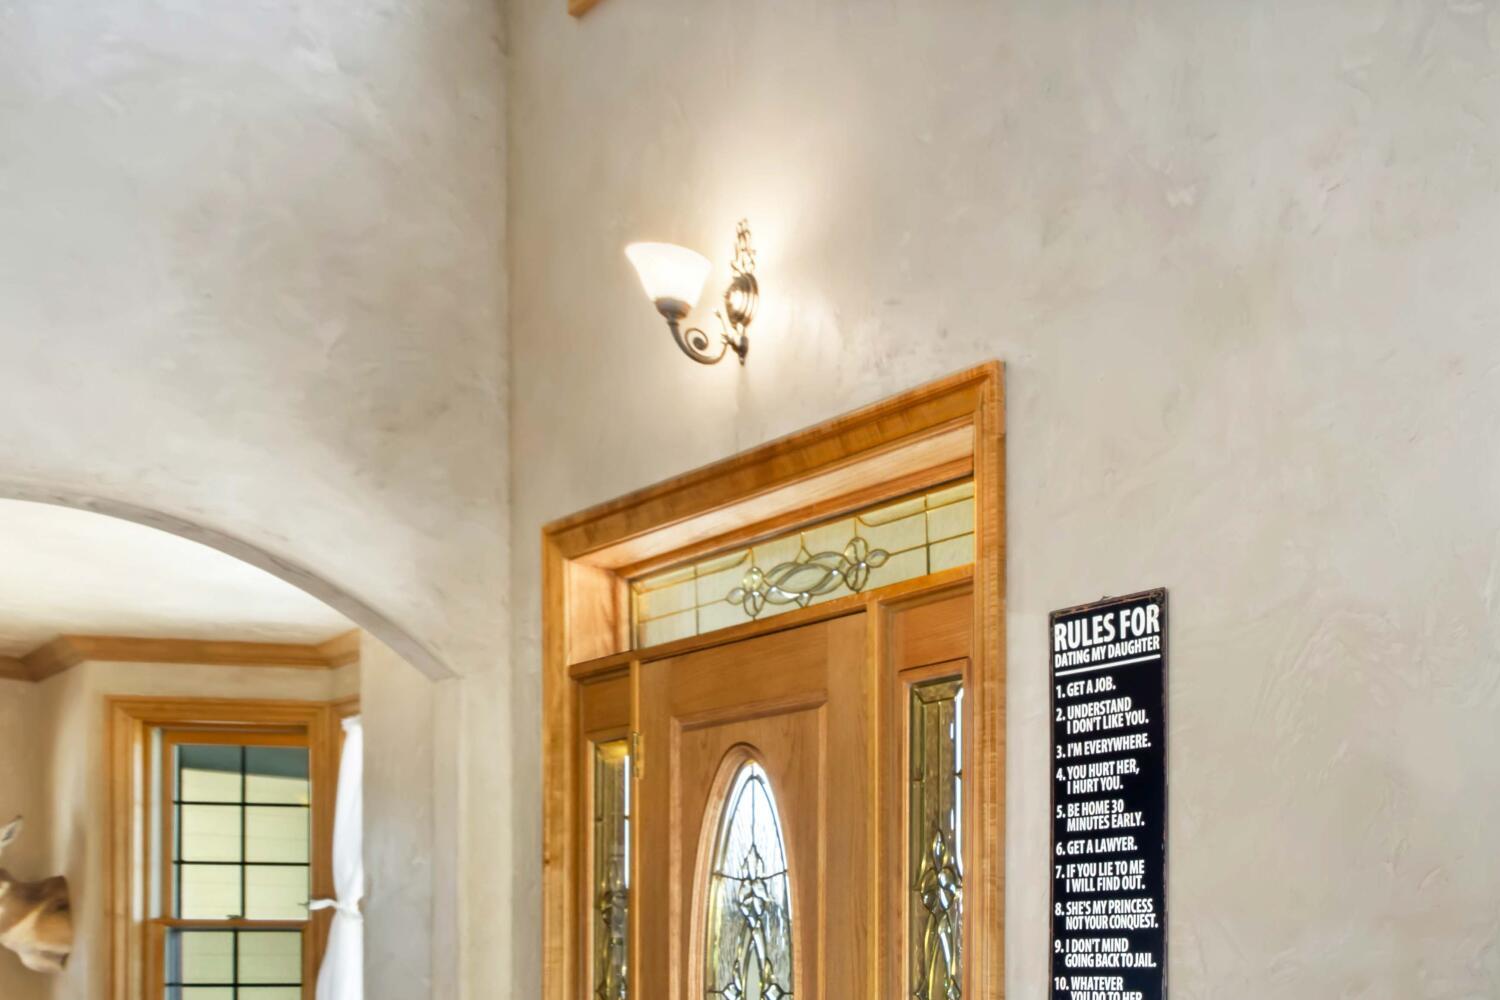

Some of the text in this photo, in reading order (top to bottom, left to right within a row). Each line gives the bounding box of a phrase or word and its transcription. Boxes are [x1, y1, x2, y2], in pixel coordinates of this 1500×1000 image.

[1054, 604, 1160, 652] RULES FOR
[1055, 636, 1160, 668] DATING MY DAUGHTER
[1056, 676, 1116, 698] 1. GET A JOB.
[1056, 697, 1131, 721] 2. UNDERSTAND
[1067, 710, 1149, 734] I DON'T LIKE YOU.
[1056, 733, 1151, 758] 3. I'M EVERYWHERE.
[1056, 759, 1139, 781] 4. YOU HURT HER,
[1067, 776, 1123, 795] I HURT YOU.
[1057, 800, 1124, 818] 5. BE HOME 30
[1067, 812, 1145, 832] MINUTES EARLY.
[1056, 836, 1137, 855] 6. GET A LAWYER.
[1056, 860, 1144, 878] 7. IF YOU LIE TO ME
[1066, 875, 1145, 892] I WILL FIND OUT.
[1055, 898, 1153, 916] 8. SHE'S MY PRINCESS
[1066, 914, 1158, 930] NOT YOUR CONQUEST.
[1055, 938, 1129, 953] 9. I DON'T MIND
[1065, 953, 1156, 968] GOING BACK TO JAIL.
[1054, 977, 1123, 991] 10. WHATEVER
